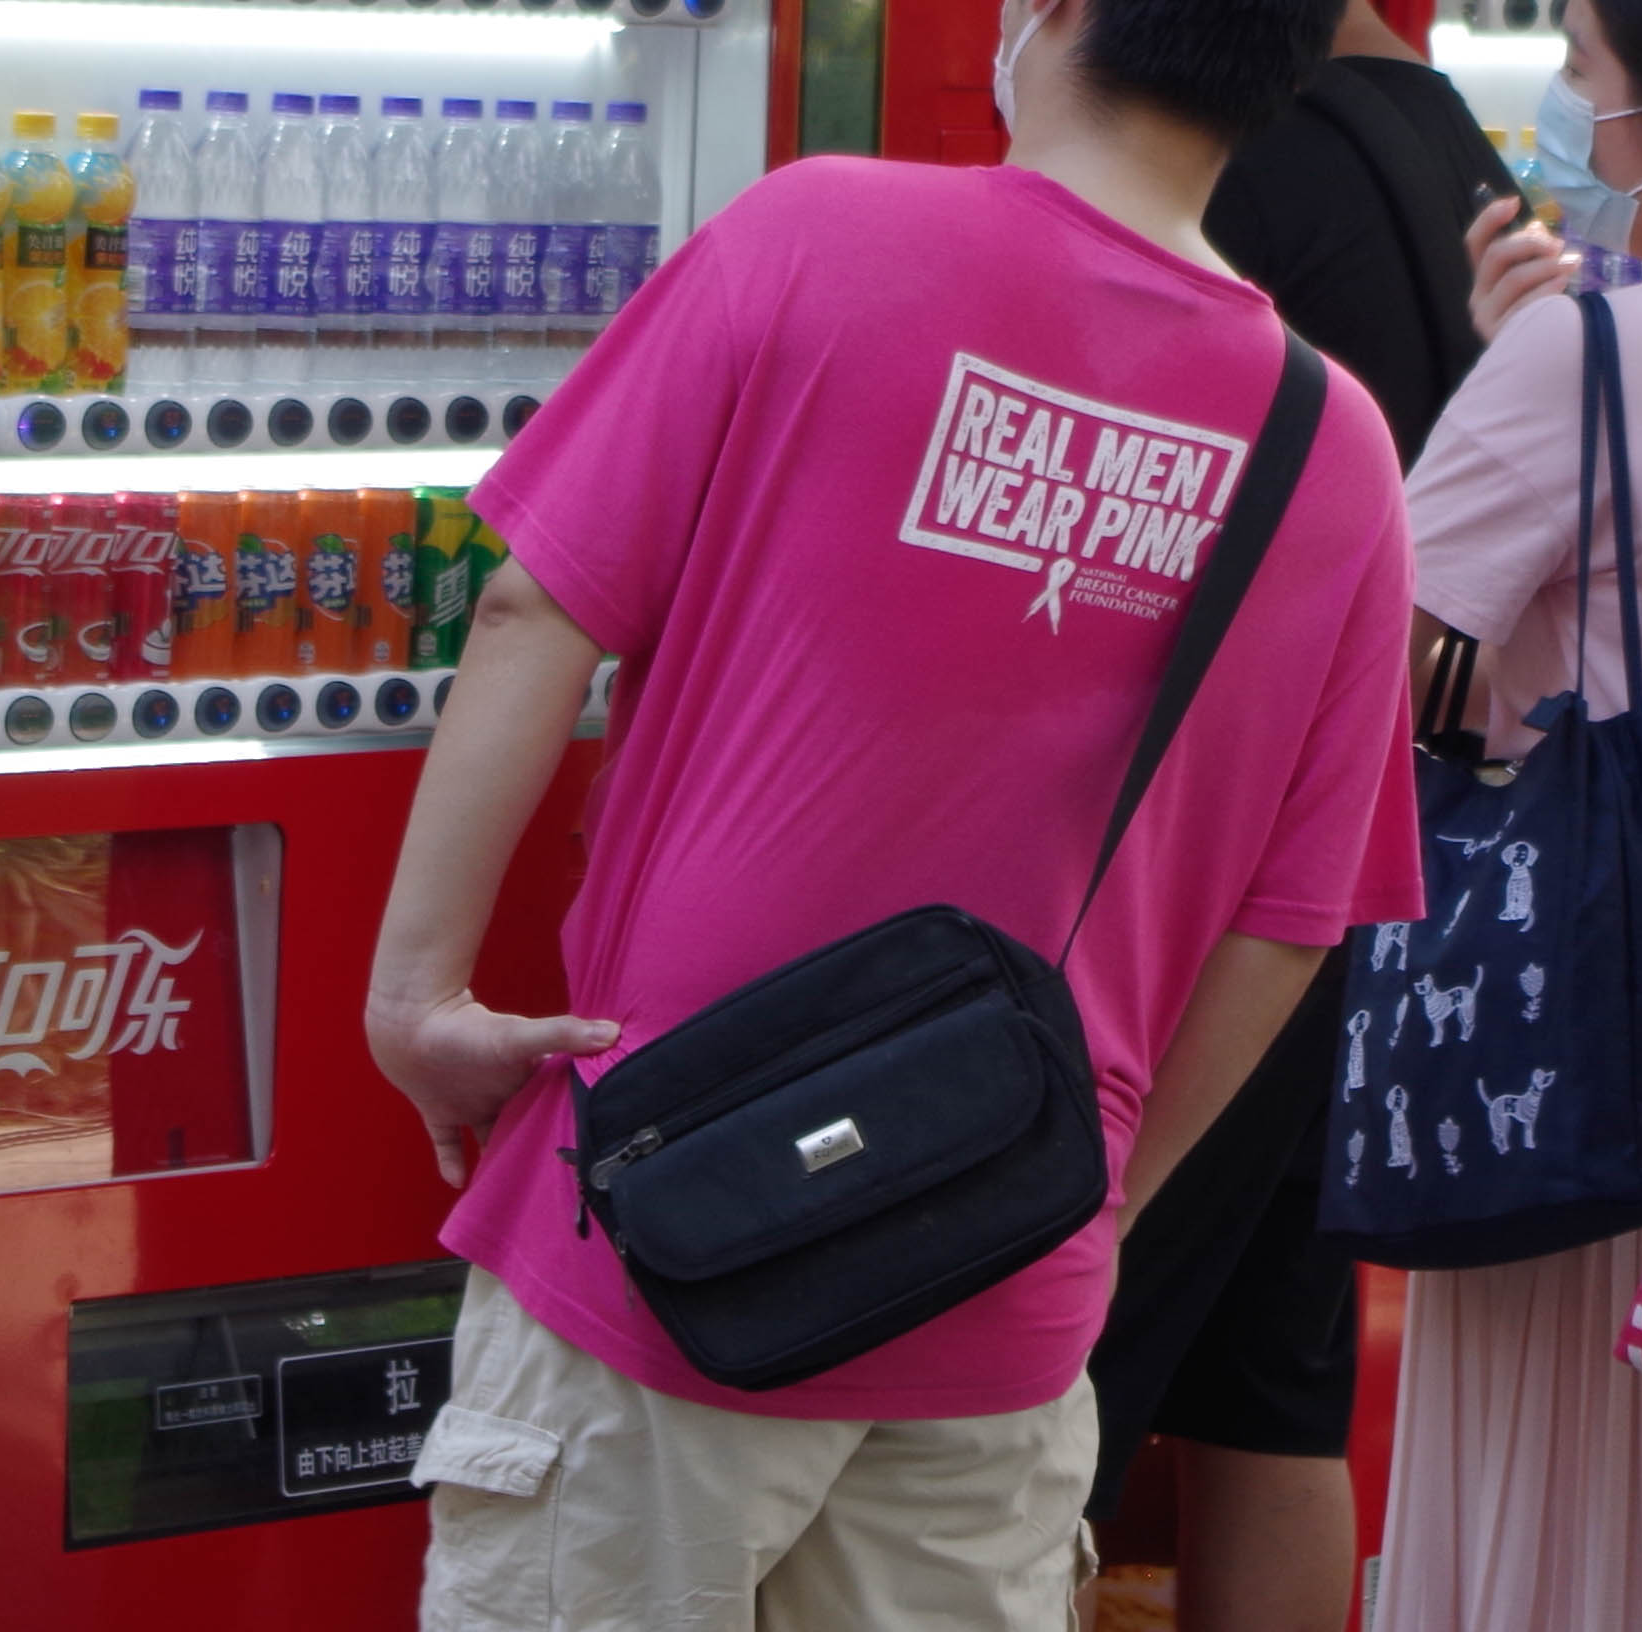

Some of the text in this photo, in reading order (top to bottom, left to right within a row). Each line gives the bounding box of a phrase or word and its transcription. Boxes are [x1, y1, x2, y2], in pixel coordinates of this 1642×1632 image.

[277, 231, 312, 299] 纯悦
[346, 230, 373, 297] 纯悦
[388, 231, 422, 297] 纯悦
[465, 232, 494, 298] 纯悦
[504, 232, 538, 298] 纯悦
[952, 384, 1213, 510] REAL MEN
[936, 453, 1217, 582] WEAR PINK
[1069, 589, 1162, 621] FOUNDATION
[1075, 576, 1179, 610] BREAST CANCER
[385, 1359, 422, 1415] 拉
